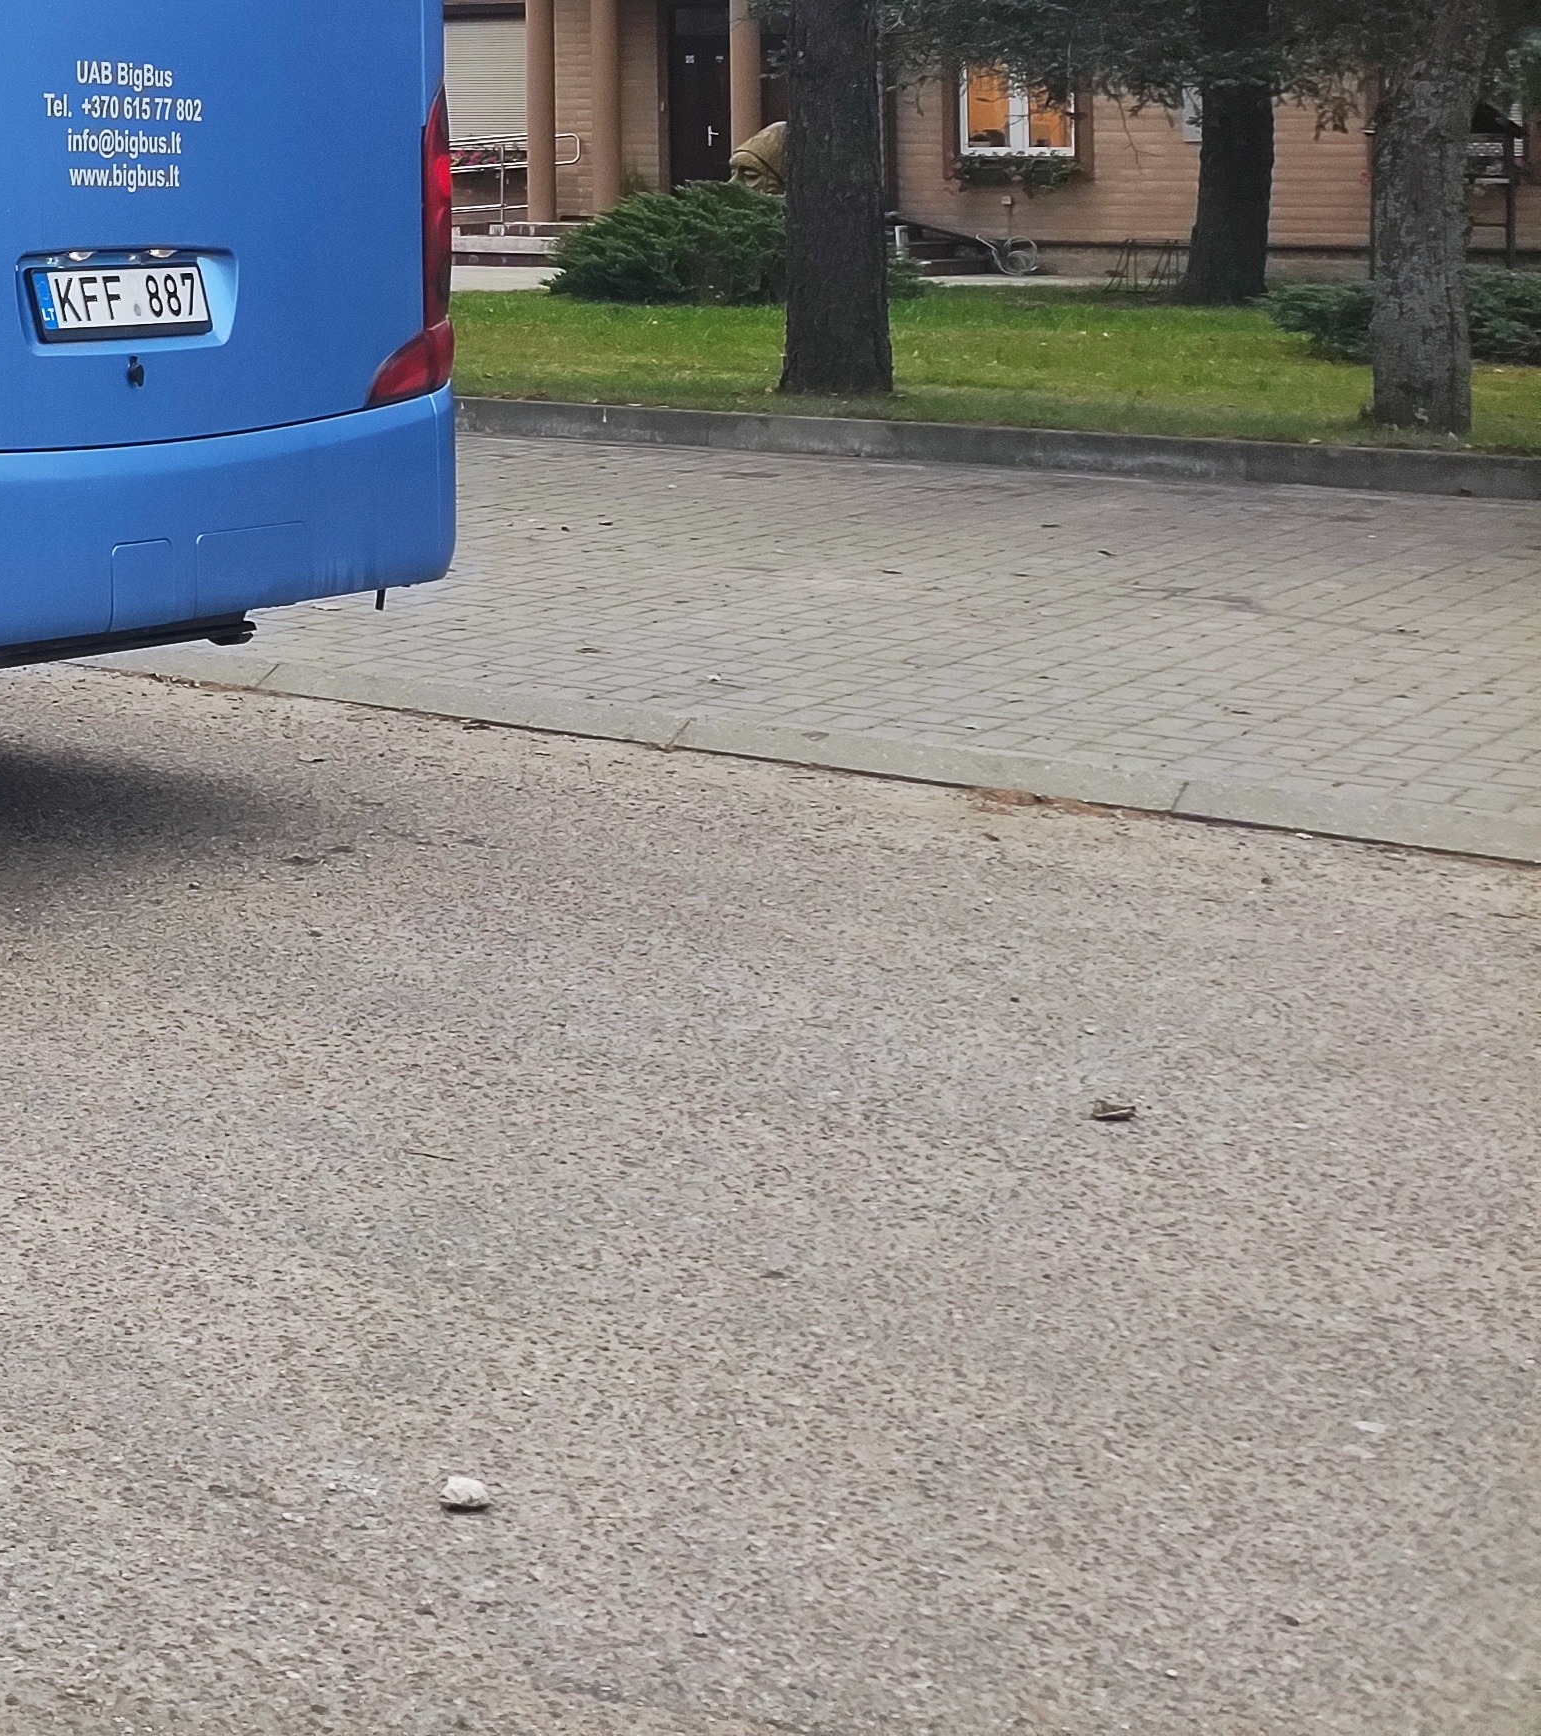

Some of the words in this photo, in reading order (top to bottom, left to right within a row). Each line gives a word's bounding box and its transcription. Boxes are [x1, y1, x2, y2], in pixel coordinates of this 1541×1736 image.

[76, 60, 113, 85] UAB
[117, 62, 173, 92] BigBus
[43, 92, 72, 118] Tel.
[81, 94, 118, 119] +370
[123, 97, 151, 120] 615
[154, 97, 172, 121] 77
[176, 98, 202, 122] 802
[67, 127, 182, 159] info@bigbus.lt
[69, 164, 180, 192] www.bigbus.lt
[54, 275, 121, 323] KFF
[145, 272, 196, 318] 887
[41, 307, 55, 322] LT
